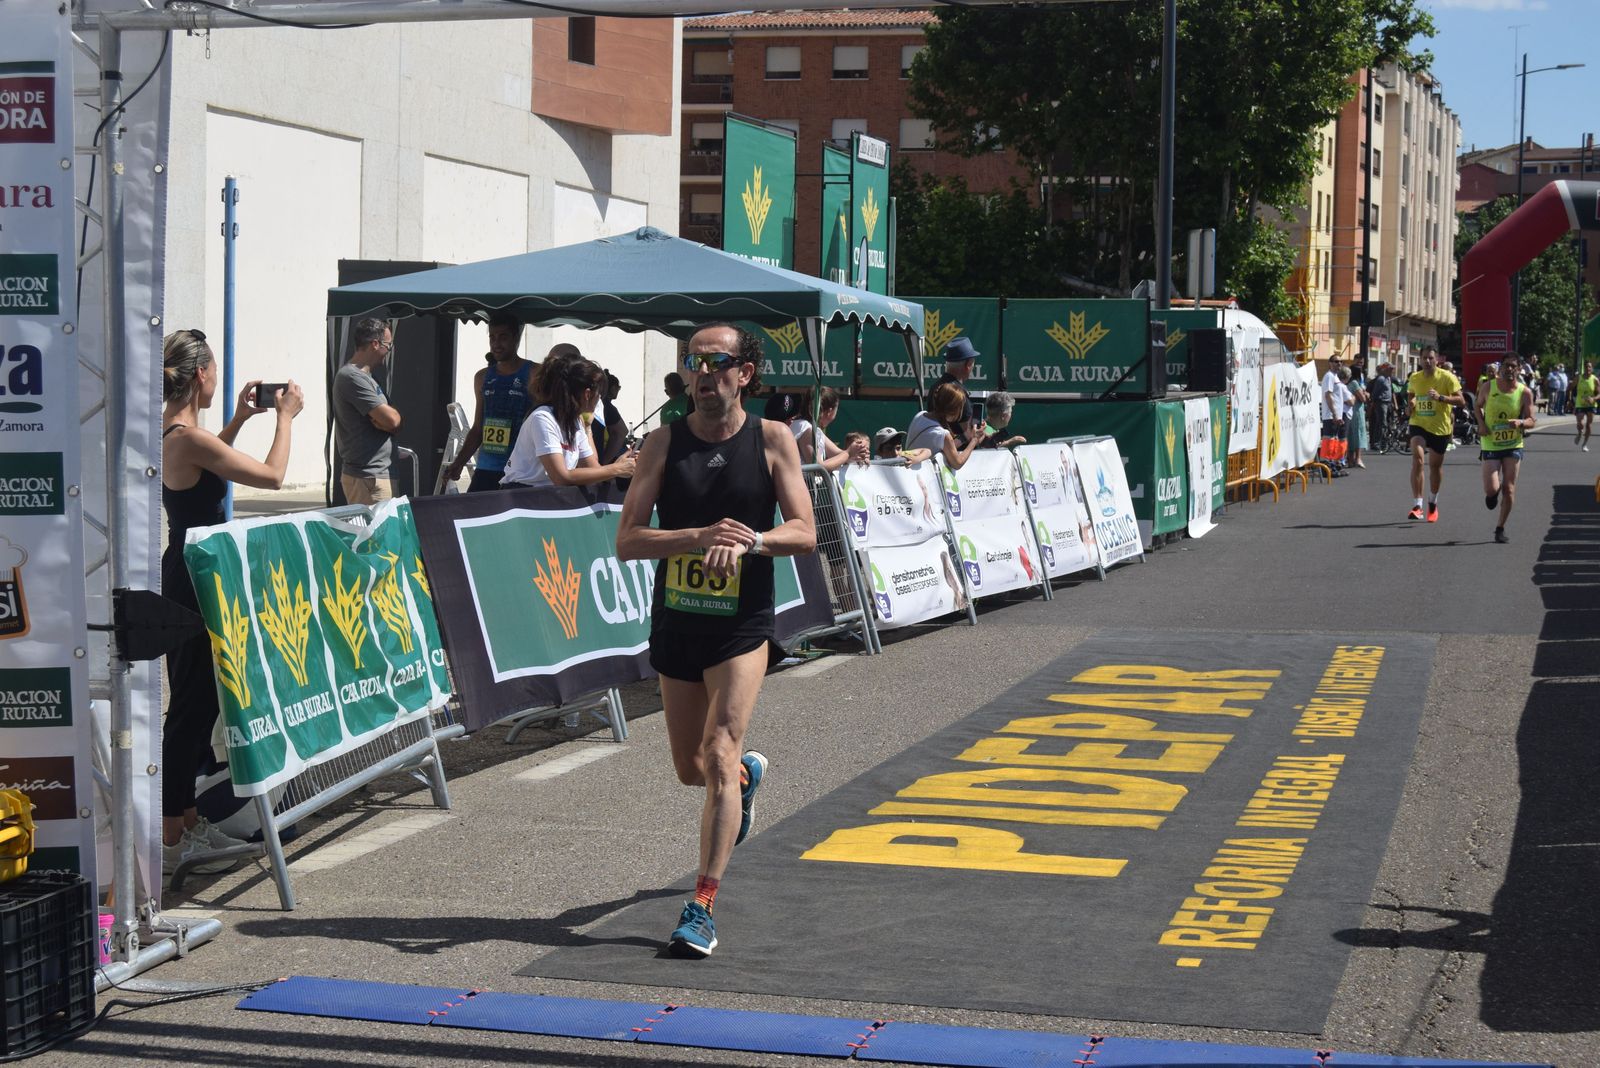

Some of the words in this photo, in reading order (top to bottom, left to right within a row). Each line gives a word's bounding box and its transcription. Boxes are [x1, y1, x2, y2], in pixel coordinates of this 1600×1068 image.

[24, 90, 46, 104] DE
[0, 293, 49, 308] URAL
[873, 361, 916, 379] CAJA
[1018, 365, 1066, 383] CAJA
[1070, 365, 1137, 382] RURAL
[1418, 401, 1433, 410] 158
[1494, 430, 1515, 441] 207
[1095, 513, 1138, 551] OCEANIC
[680, 597, 701, 609] CAJA
[703, 599, 734, 611] RURAL
[2, 706, 63, 720] RURAL
[303, 691, 335, 719] RURAL
[799, 664, 1282, 878] PIDEPAR
[1157, 837, 1310, 950] REFORMA
[1235, 753, 1347, 829] INTEGRAL
[1291, 697, 1367, 738] DISEÑO
